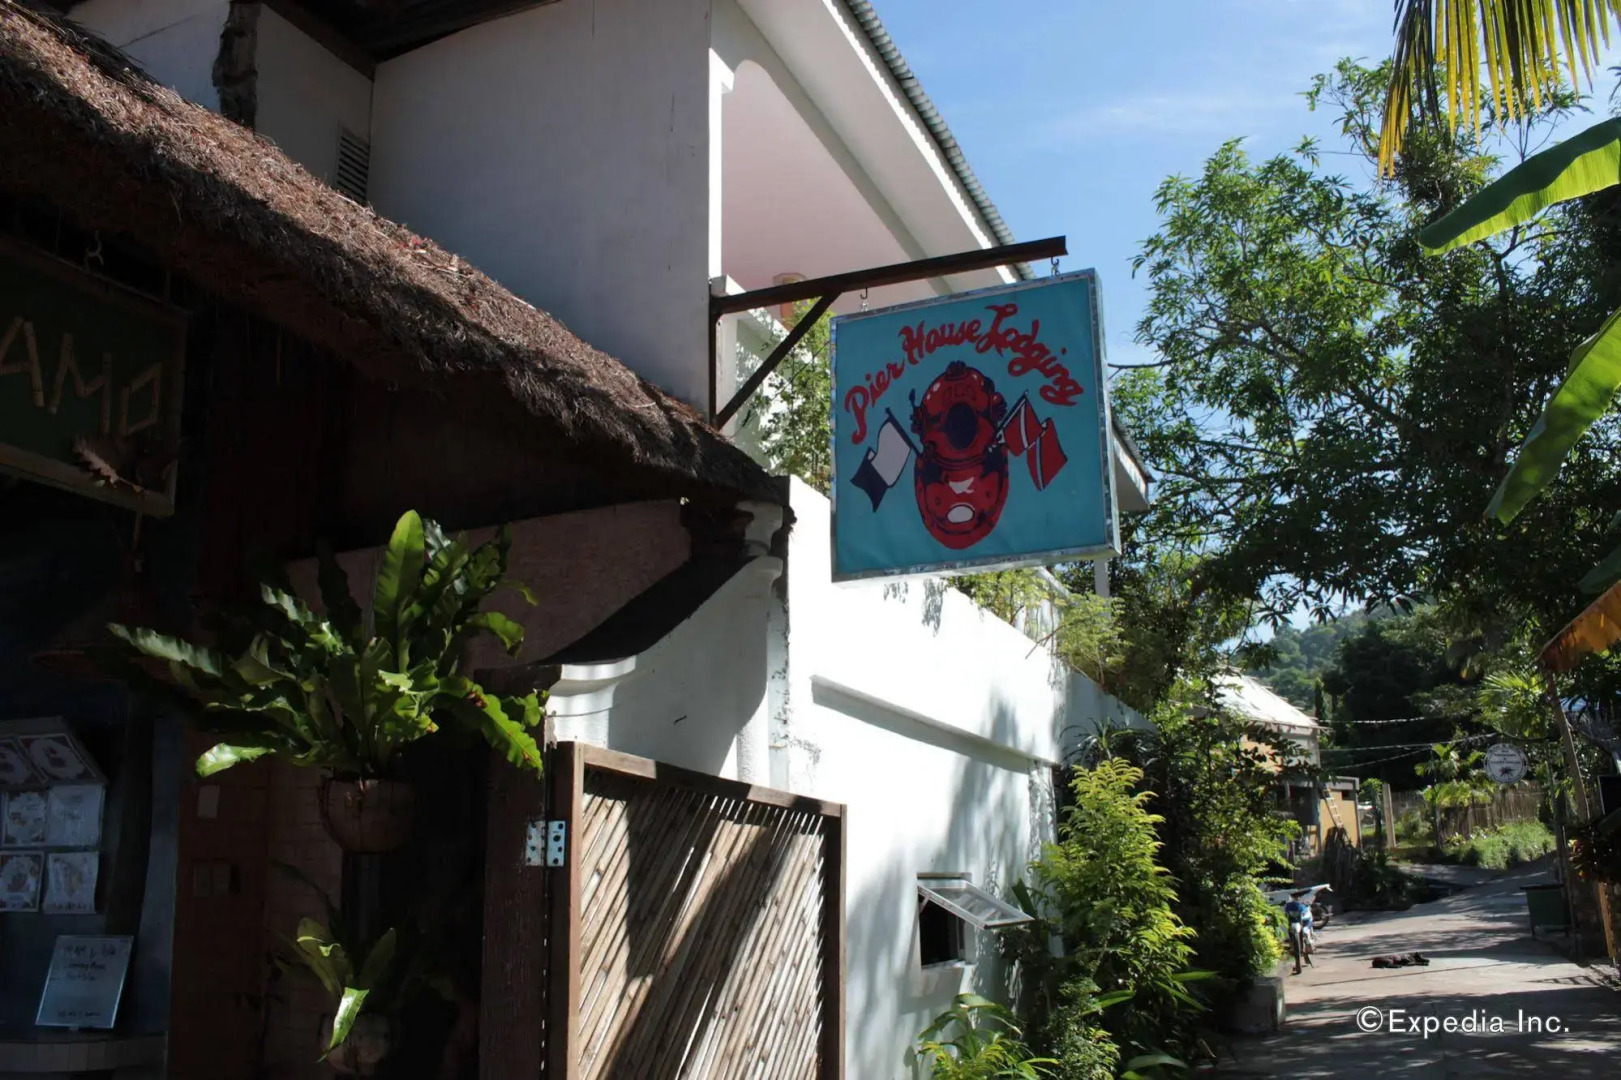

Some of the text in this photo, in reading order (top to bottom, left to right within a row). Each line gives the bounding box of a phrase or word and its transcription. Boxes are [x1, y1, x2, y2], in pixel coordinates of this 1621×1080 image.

[844, 303, 1084, 445] Pier House Lodging
